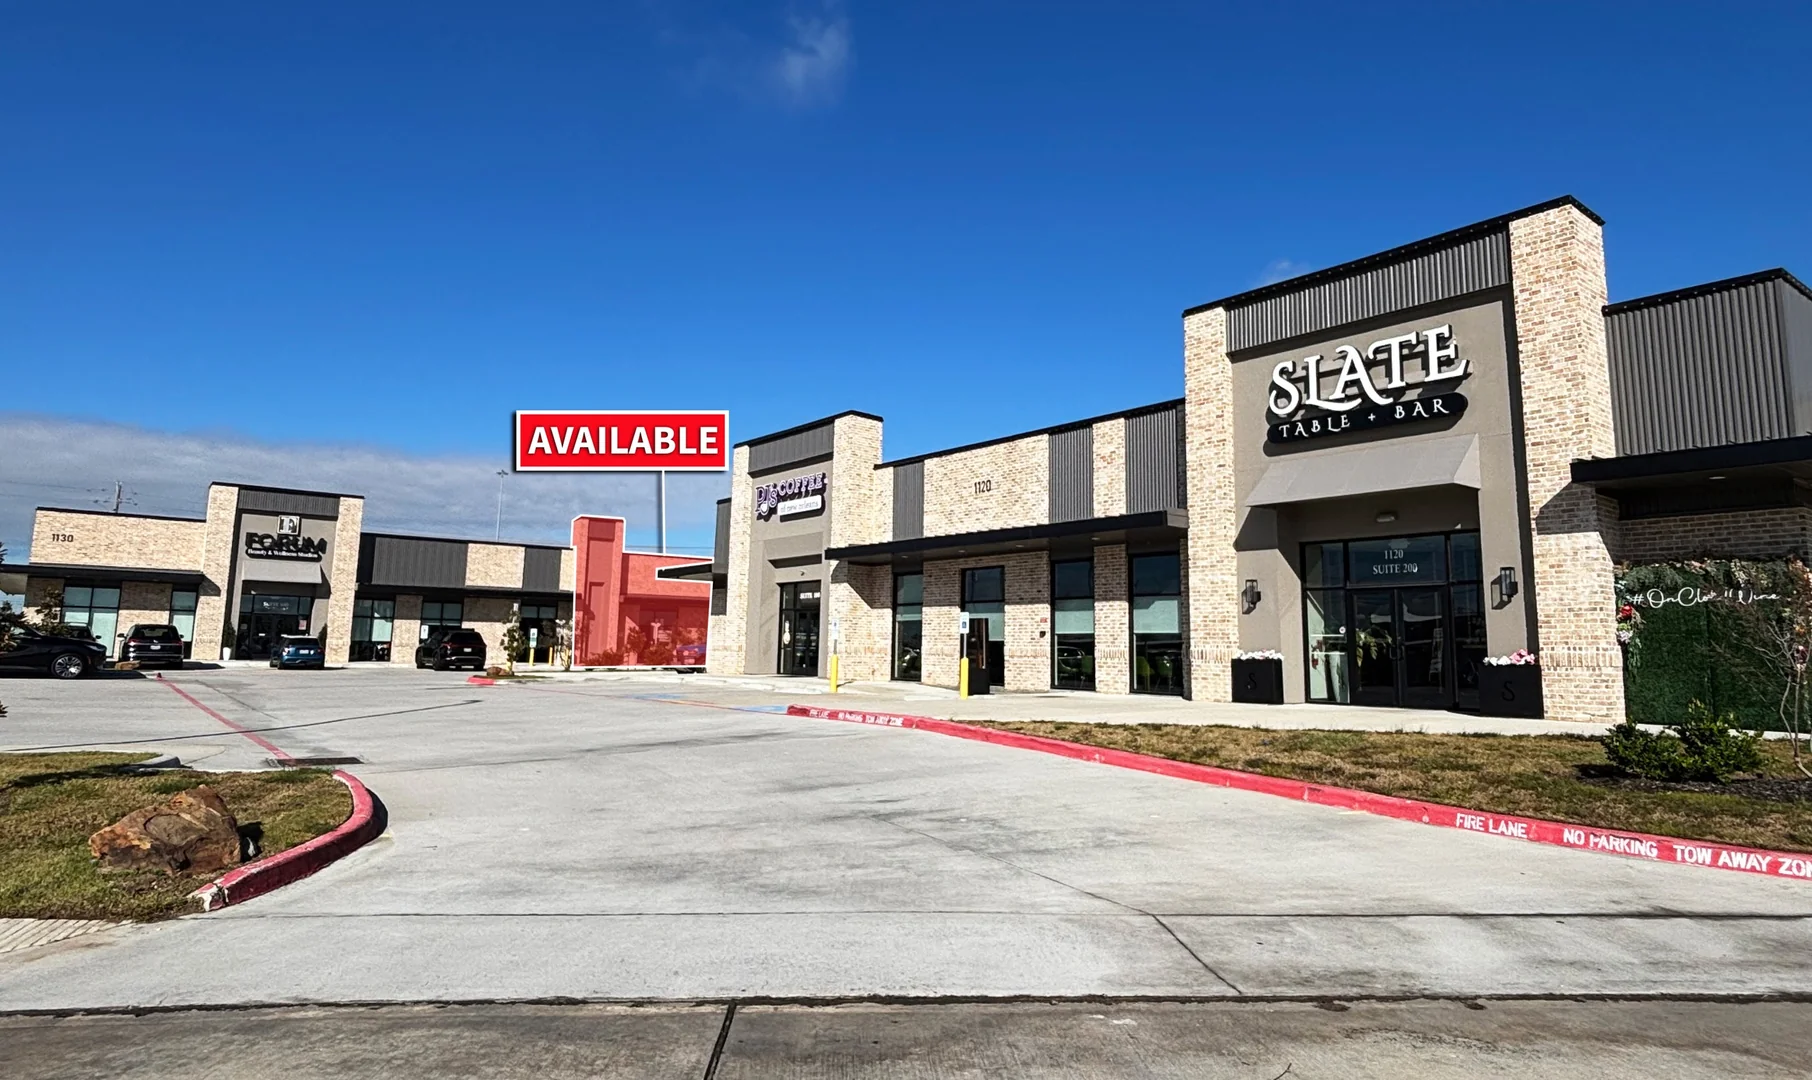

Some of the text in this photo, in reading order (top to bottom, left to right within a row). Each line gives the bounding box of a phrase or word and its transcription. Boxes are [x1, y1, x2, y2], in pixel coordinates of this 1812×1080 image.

[1269, 324, 1468, 415] SLATE
[1278, 414, 1350, 438] TABLE
[1394, 398, 1450, 419] BAR
[778, 472, 823, 496] COFFEE
[974, 479, 992, 494] 1120
[52, 533, 74, 543] 1130
[245, 532, 328, 555] FORUM
[1384, 549, 1404, 560] 1120
[1372, 562, 1418, 575] SUITE 200
[838, 712, 844, 720] NO
[1456, 813, 1486, 831] FIRE
[1489, 819, 1528, 838] LANE
[1563, 828, 1585, 845] NO
[1590, 832, 1658, 858] PARKING
[1673, 845, 1712, 865] TOW
[1718, 851, 1772, 872] AWAY
